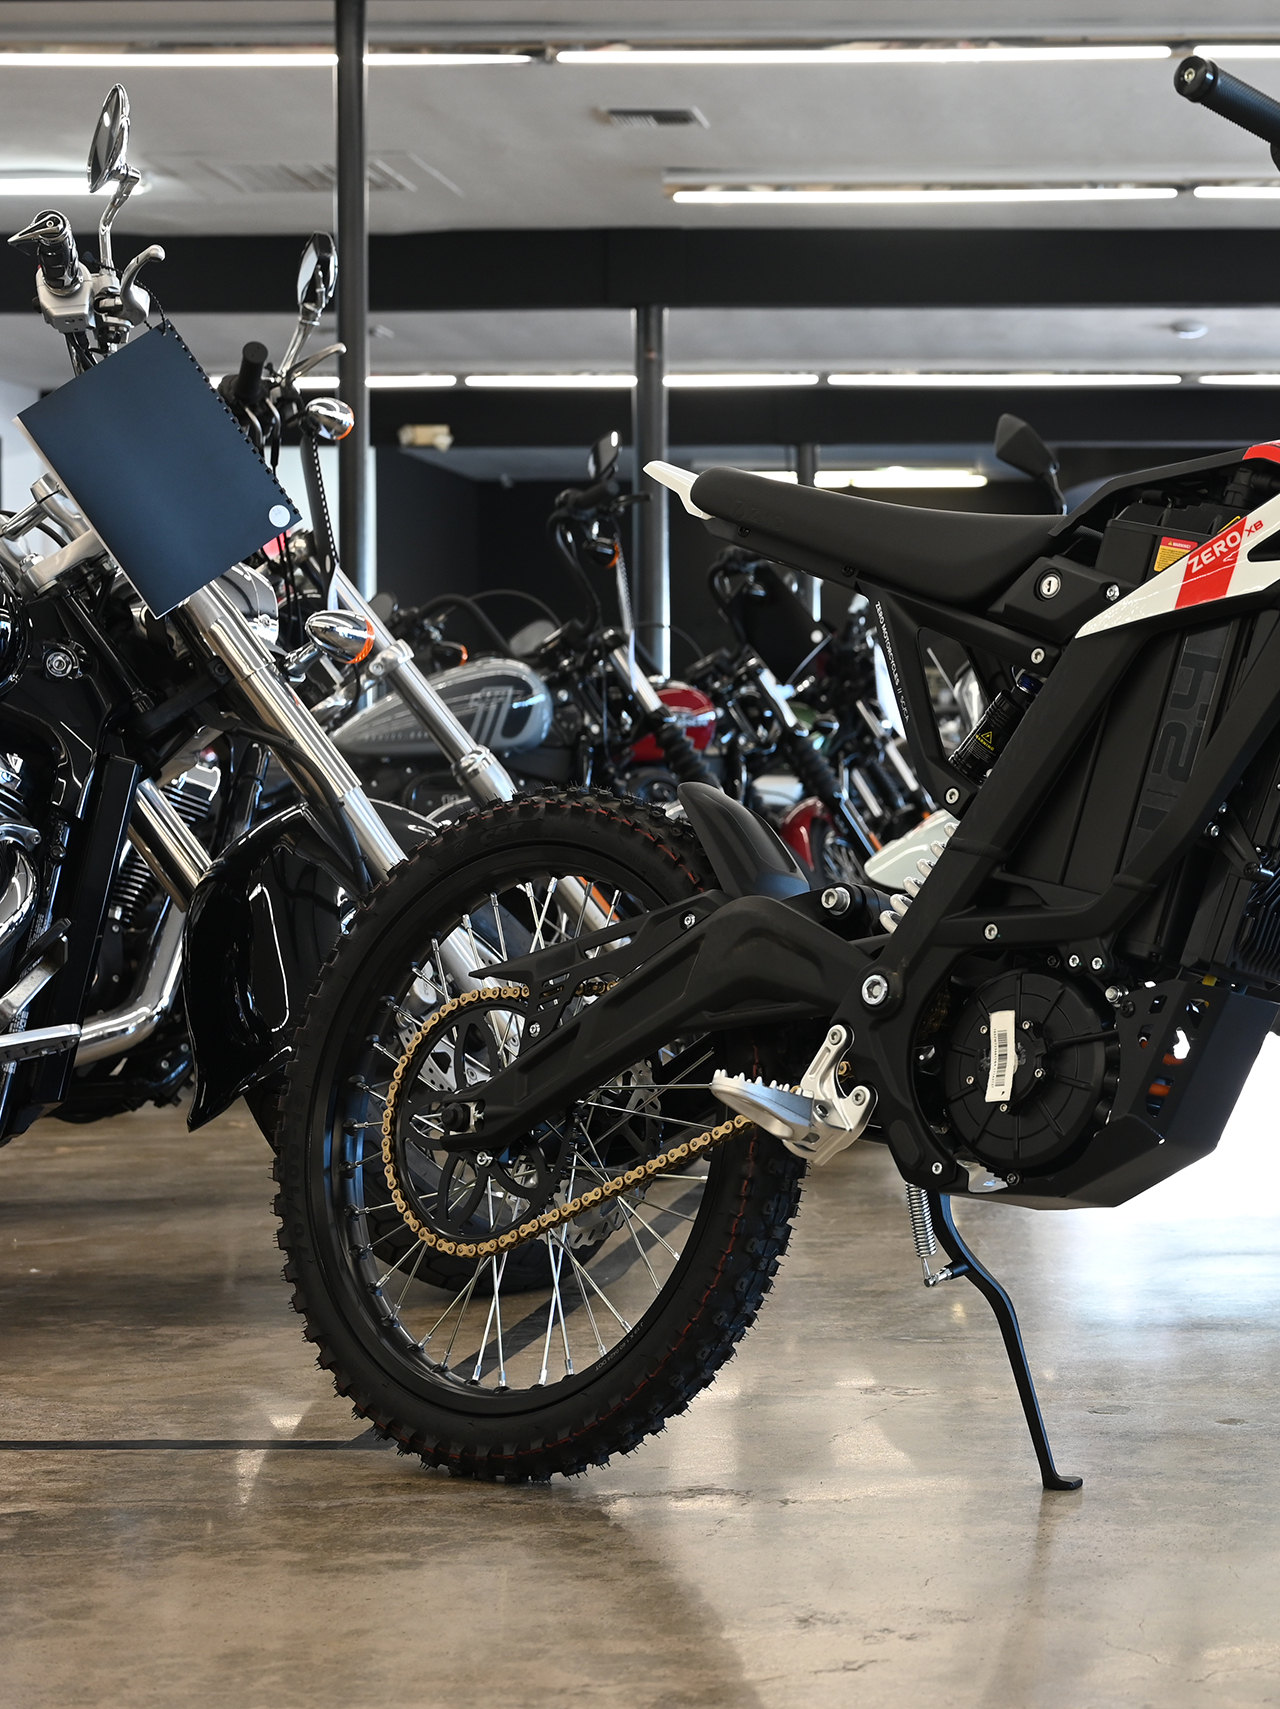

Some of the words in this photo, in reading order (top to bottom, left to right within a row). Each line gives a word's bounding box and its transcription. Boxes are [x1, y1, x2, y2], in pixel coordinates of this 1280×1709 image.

[1172, 541, 1191, 549] WARNING!
[1188, 531, 1241, 574] ZERO
[1245, 520, 1264, 537] XB
[874, 601, 885, 623] ZERO
[881, 624, 900, 686] MOTORCYCLES
[975, 733, 995, 752] WARNING
